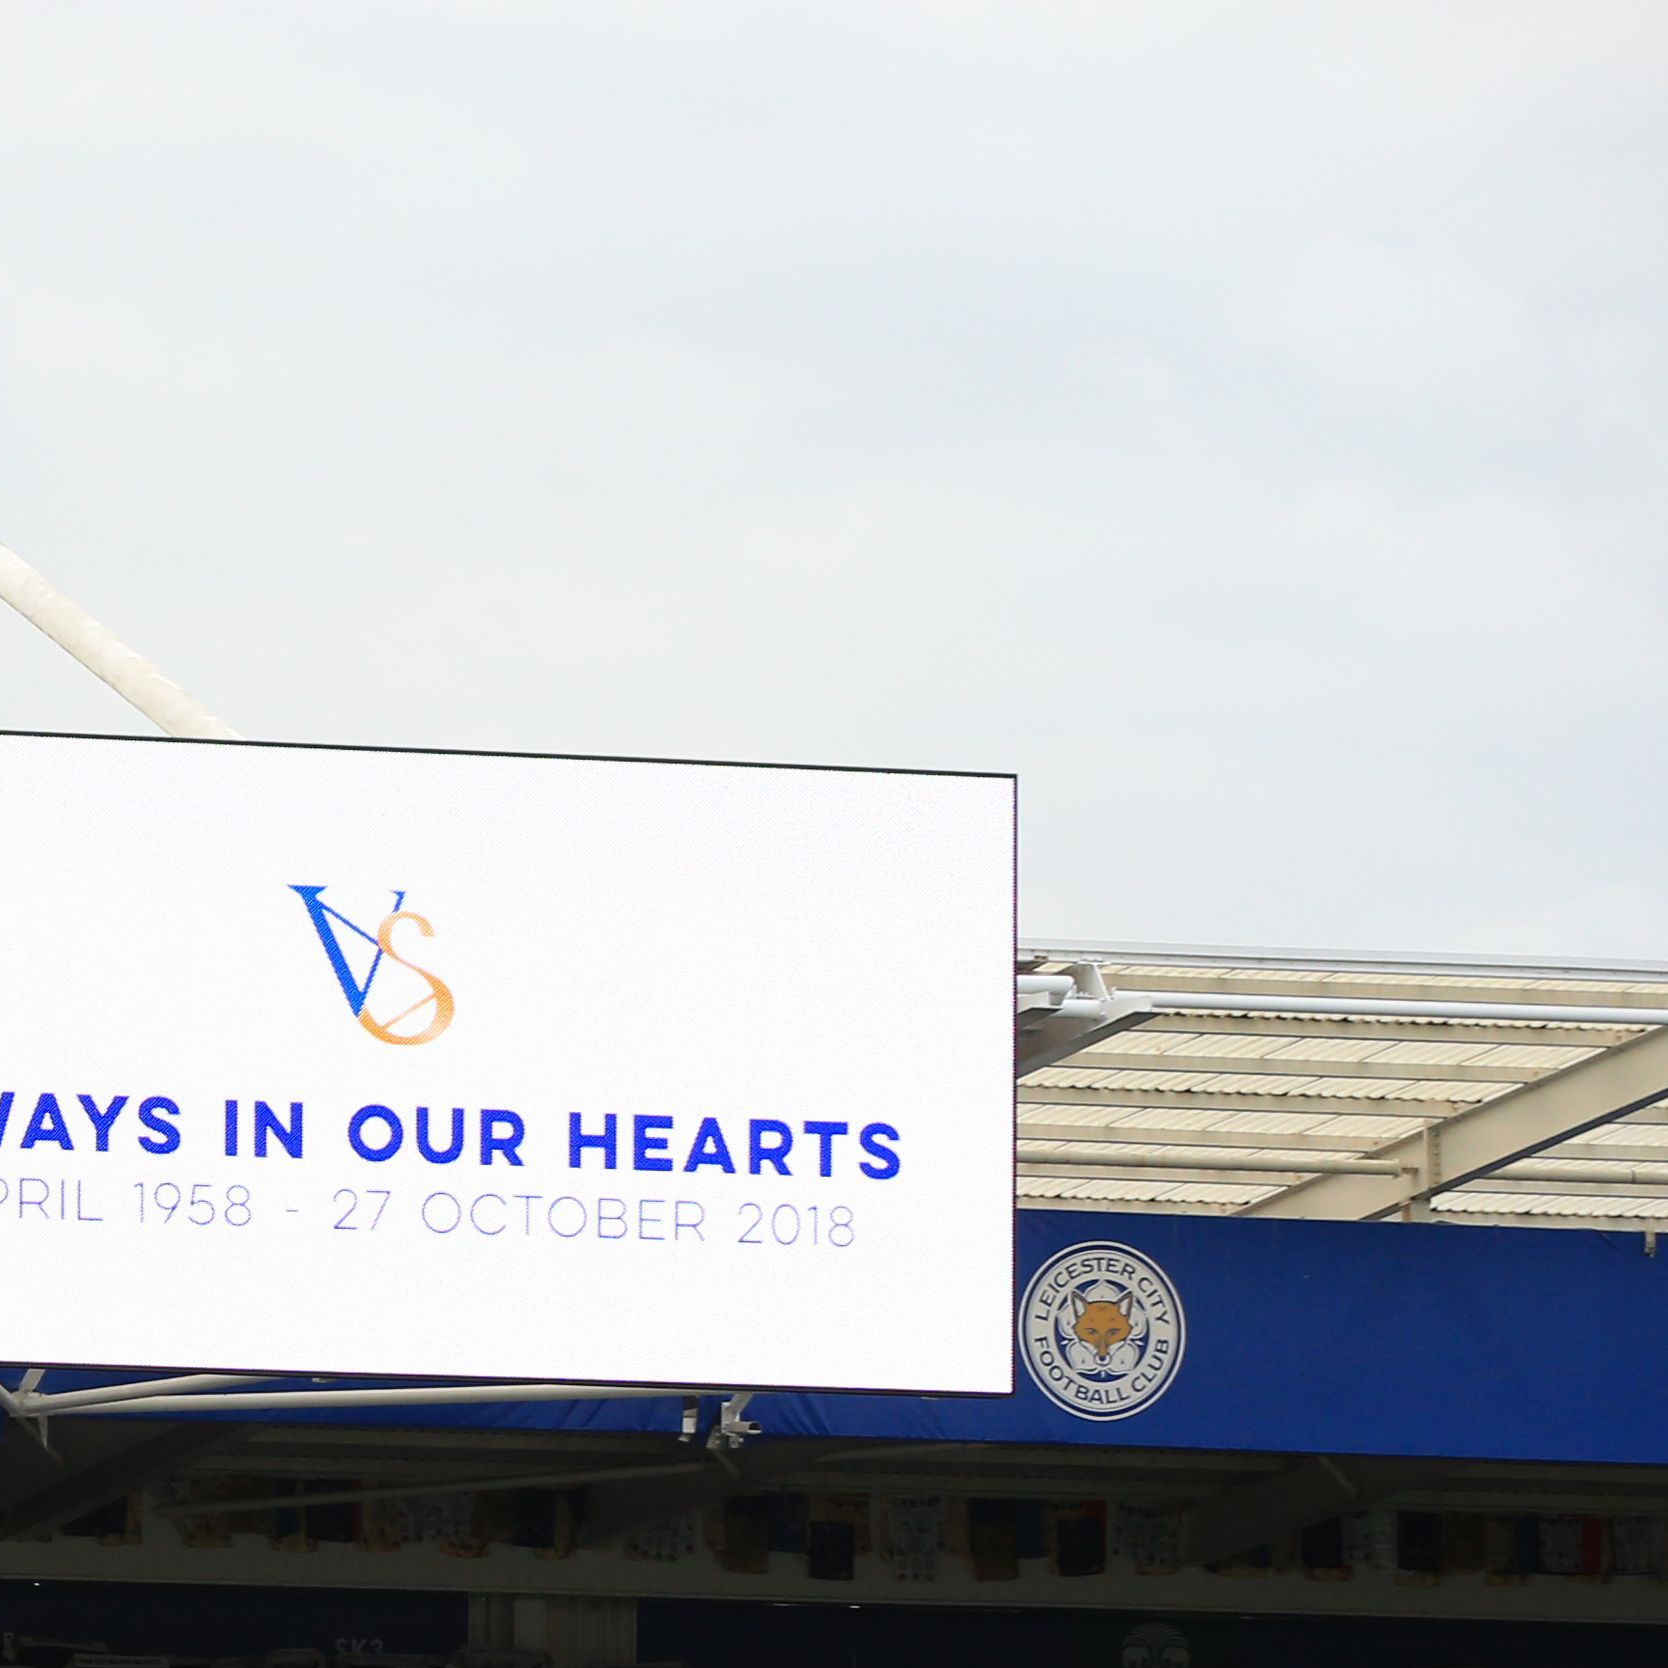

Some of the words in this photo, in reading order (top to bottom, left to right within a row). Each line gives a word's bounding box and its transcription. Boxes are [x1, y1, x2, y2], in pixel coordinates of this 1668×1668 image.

[224, 1099, 304, 1159] IN
[347, 1105, 526, 1167] OUR
[568, 1111, 902, 1181] HEARTS
[134, 1182, 251, 1227] 1958
[334, 1189, 391, 1231] 27
[422, 1192, 705, 1242] OCTOBER
[738, 1203, 854, 1247] 2018
[1035, 1257, 1137, 1322] LEICESTER
[1137, 1277, 1171, 1326] CITY
[1034, 1336, 1131, 1405] FOOTBALL
[1131, 1339, 1171, 1393] CLUB
